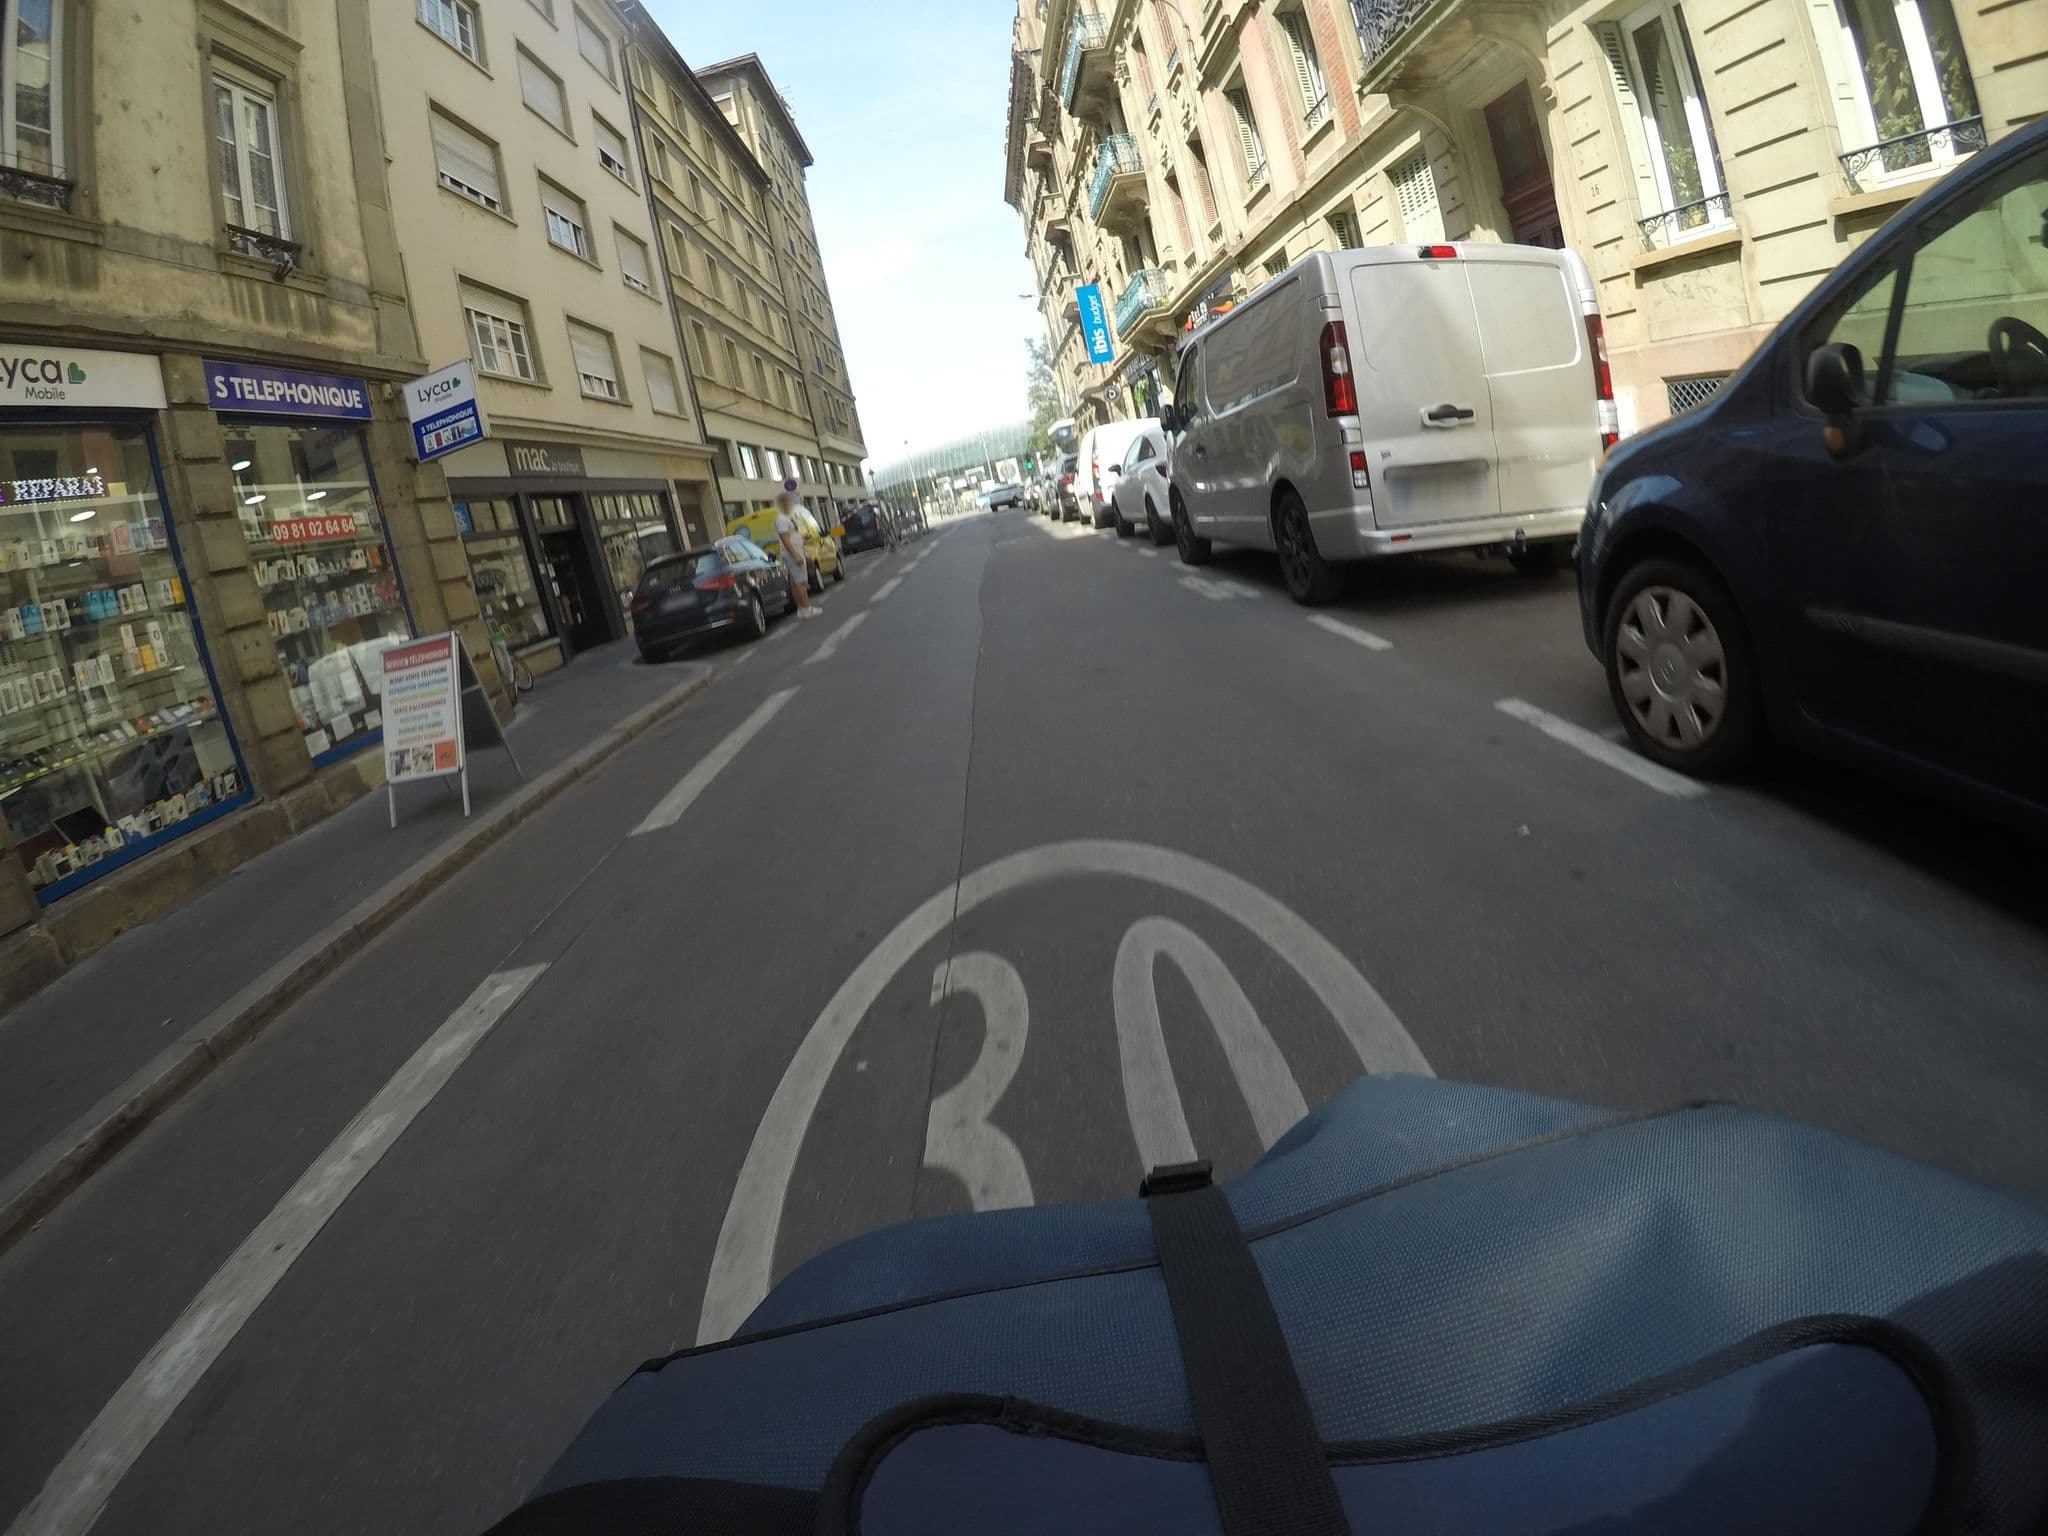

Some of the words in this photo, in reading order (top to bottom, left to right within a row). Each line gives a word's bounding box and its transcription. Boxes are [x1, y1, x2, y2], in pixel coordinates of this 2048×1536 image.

[1088, 294, 1102, 324] budget
[1092, 328, 1109, 355] ibis
[0, 358, 63, 389] yca
[25, 386, 66, 400] Mobile
[214, 375, 229, 399] S
[230, 377, 363, 409] TELEPHONIQUE
[417, 380, 451, 403] Lyca
[426, 406, 474, 432] TELEPHONIQUE
[514, 446, 551, 472] mac
[273, 524, 289, 541] 09
[291, 522, 306, 539] 81
[309, 520, 324, 536] 02
[325, 519, 340, 535] 64
[341, 518, 356, 533] 64
